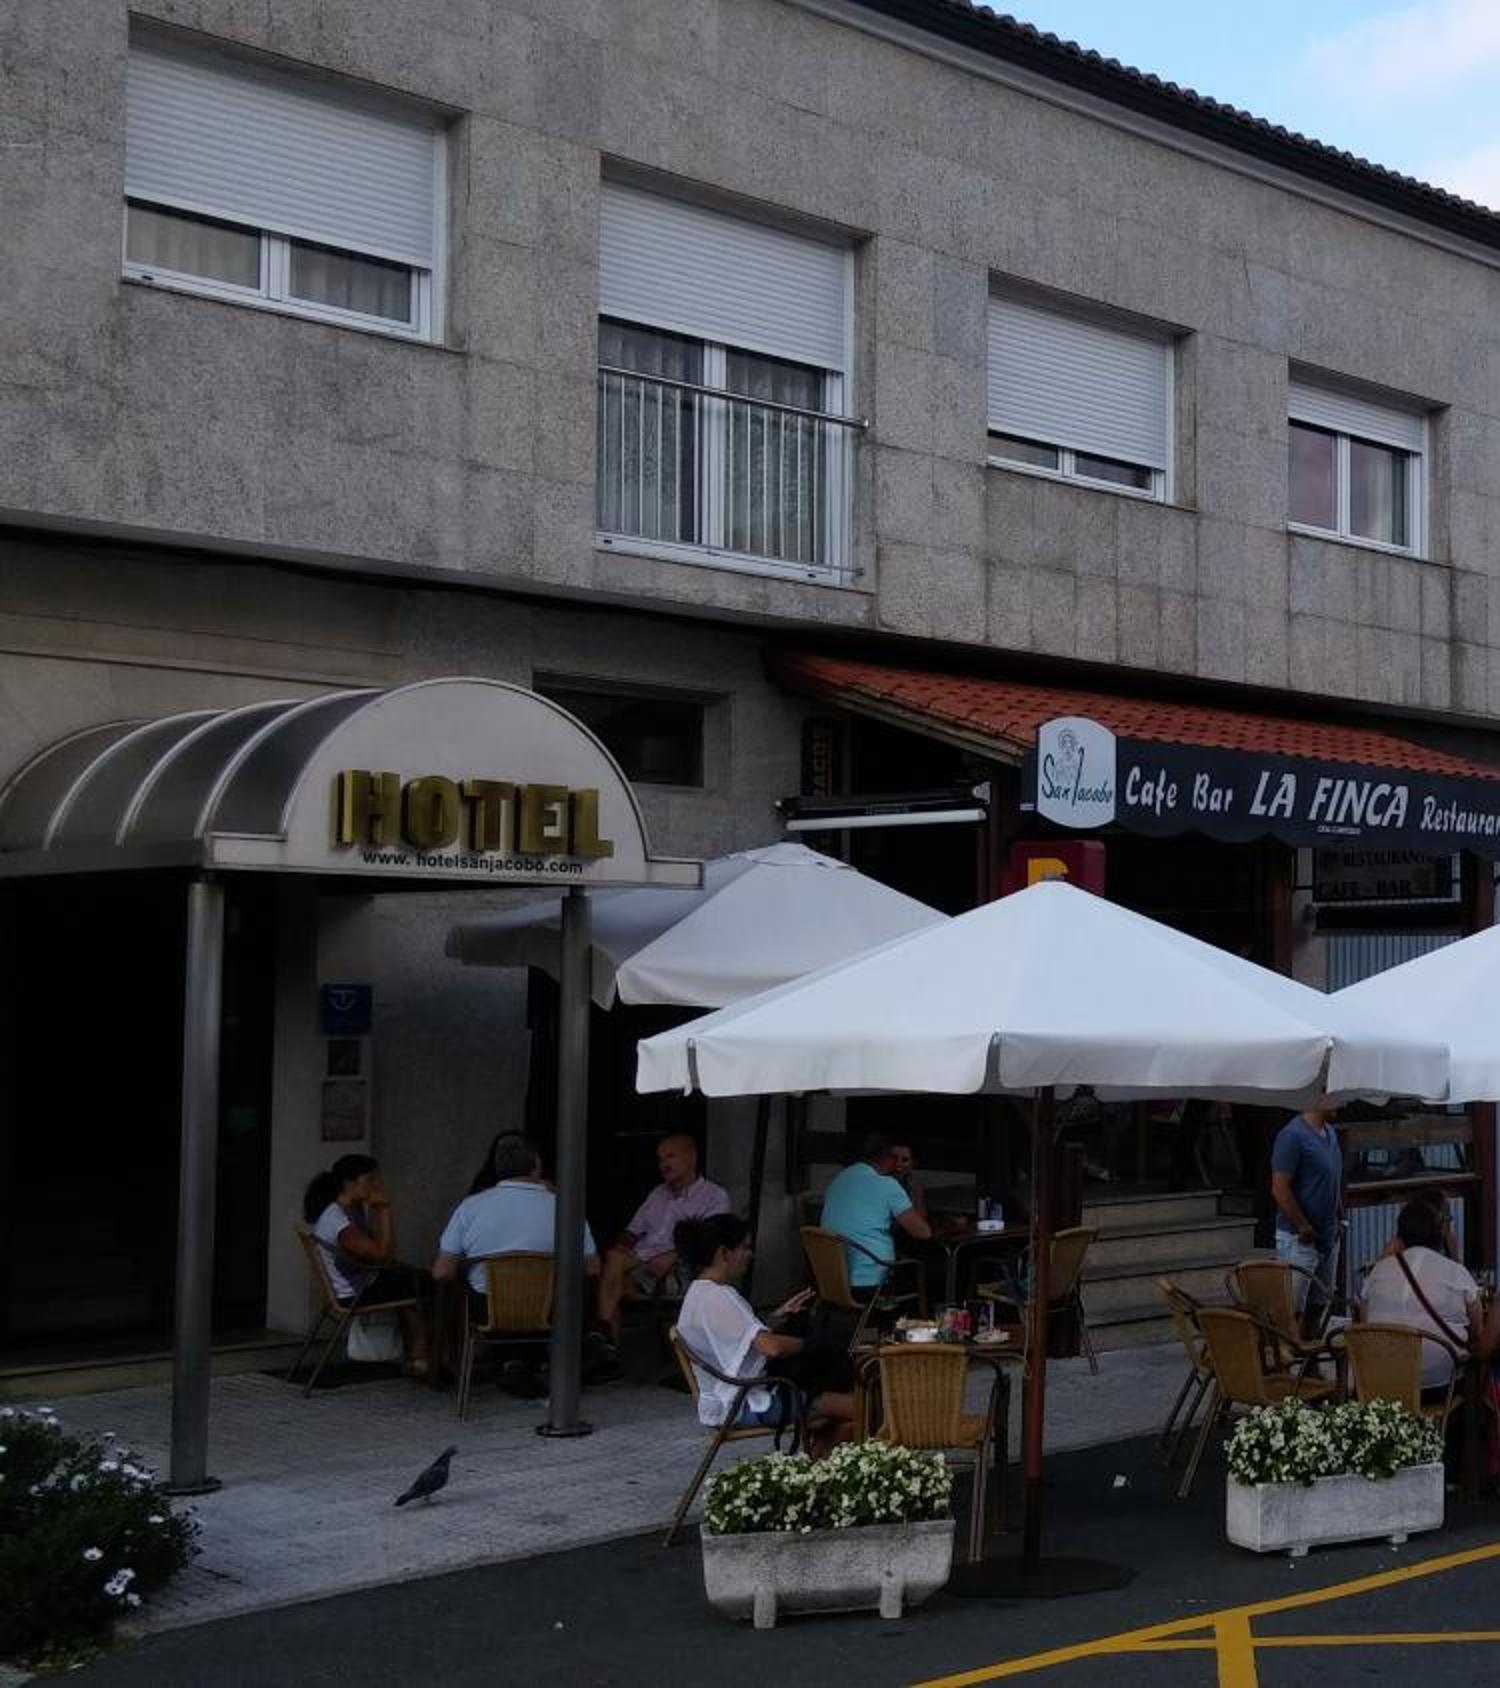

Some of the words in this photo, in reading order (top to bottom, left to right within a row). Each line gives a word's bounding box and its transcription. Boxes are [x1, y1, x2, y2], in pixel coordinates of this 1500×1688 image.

[334, 769, 614, 860] HOTEL
[1125, 765, 1177, 816] Cafe
[1191, 771, 1233, 813] Bar
[1248, 770, 1298, 818] LA
[1307, 776, 1410, 829] FINCA
